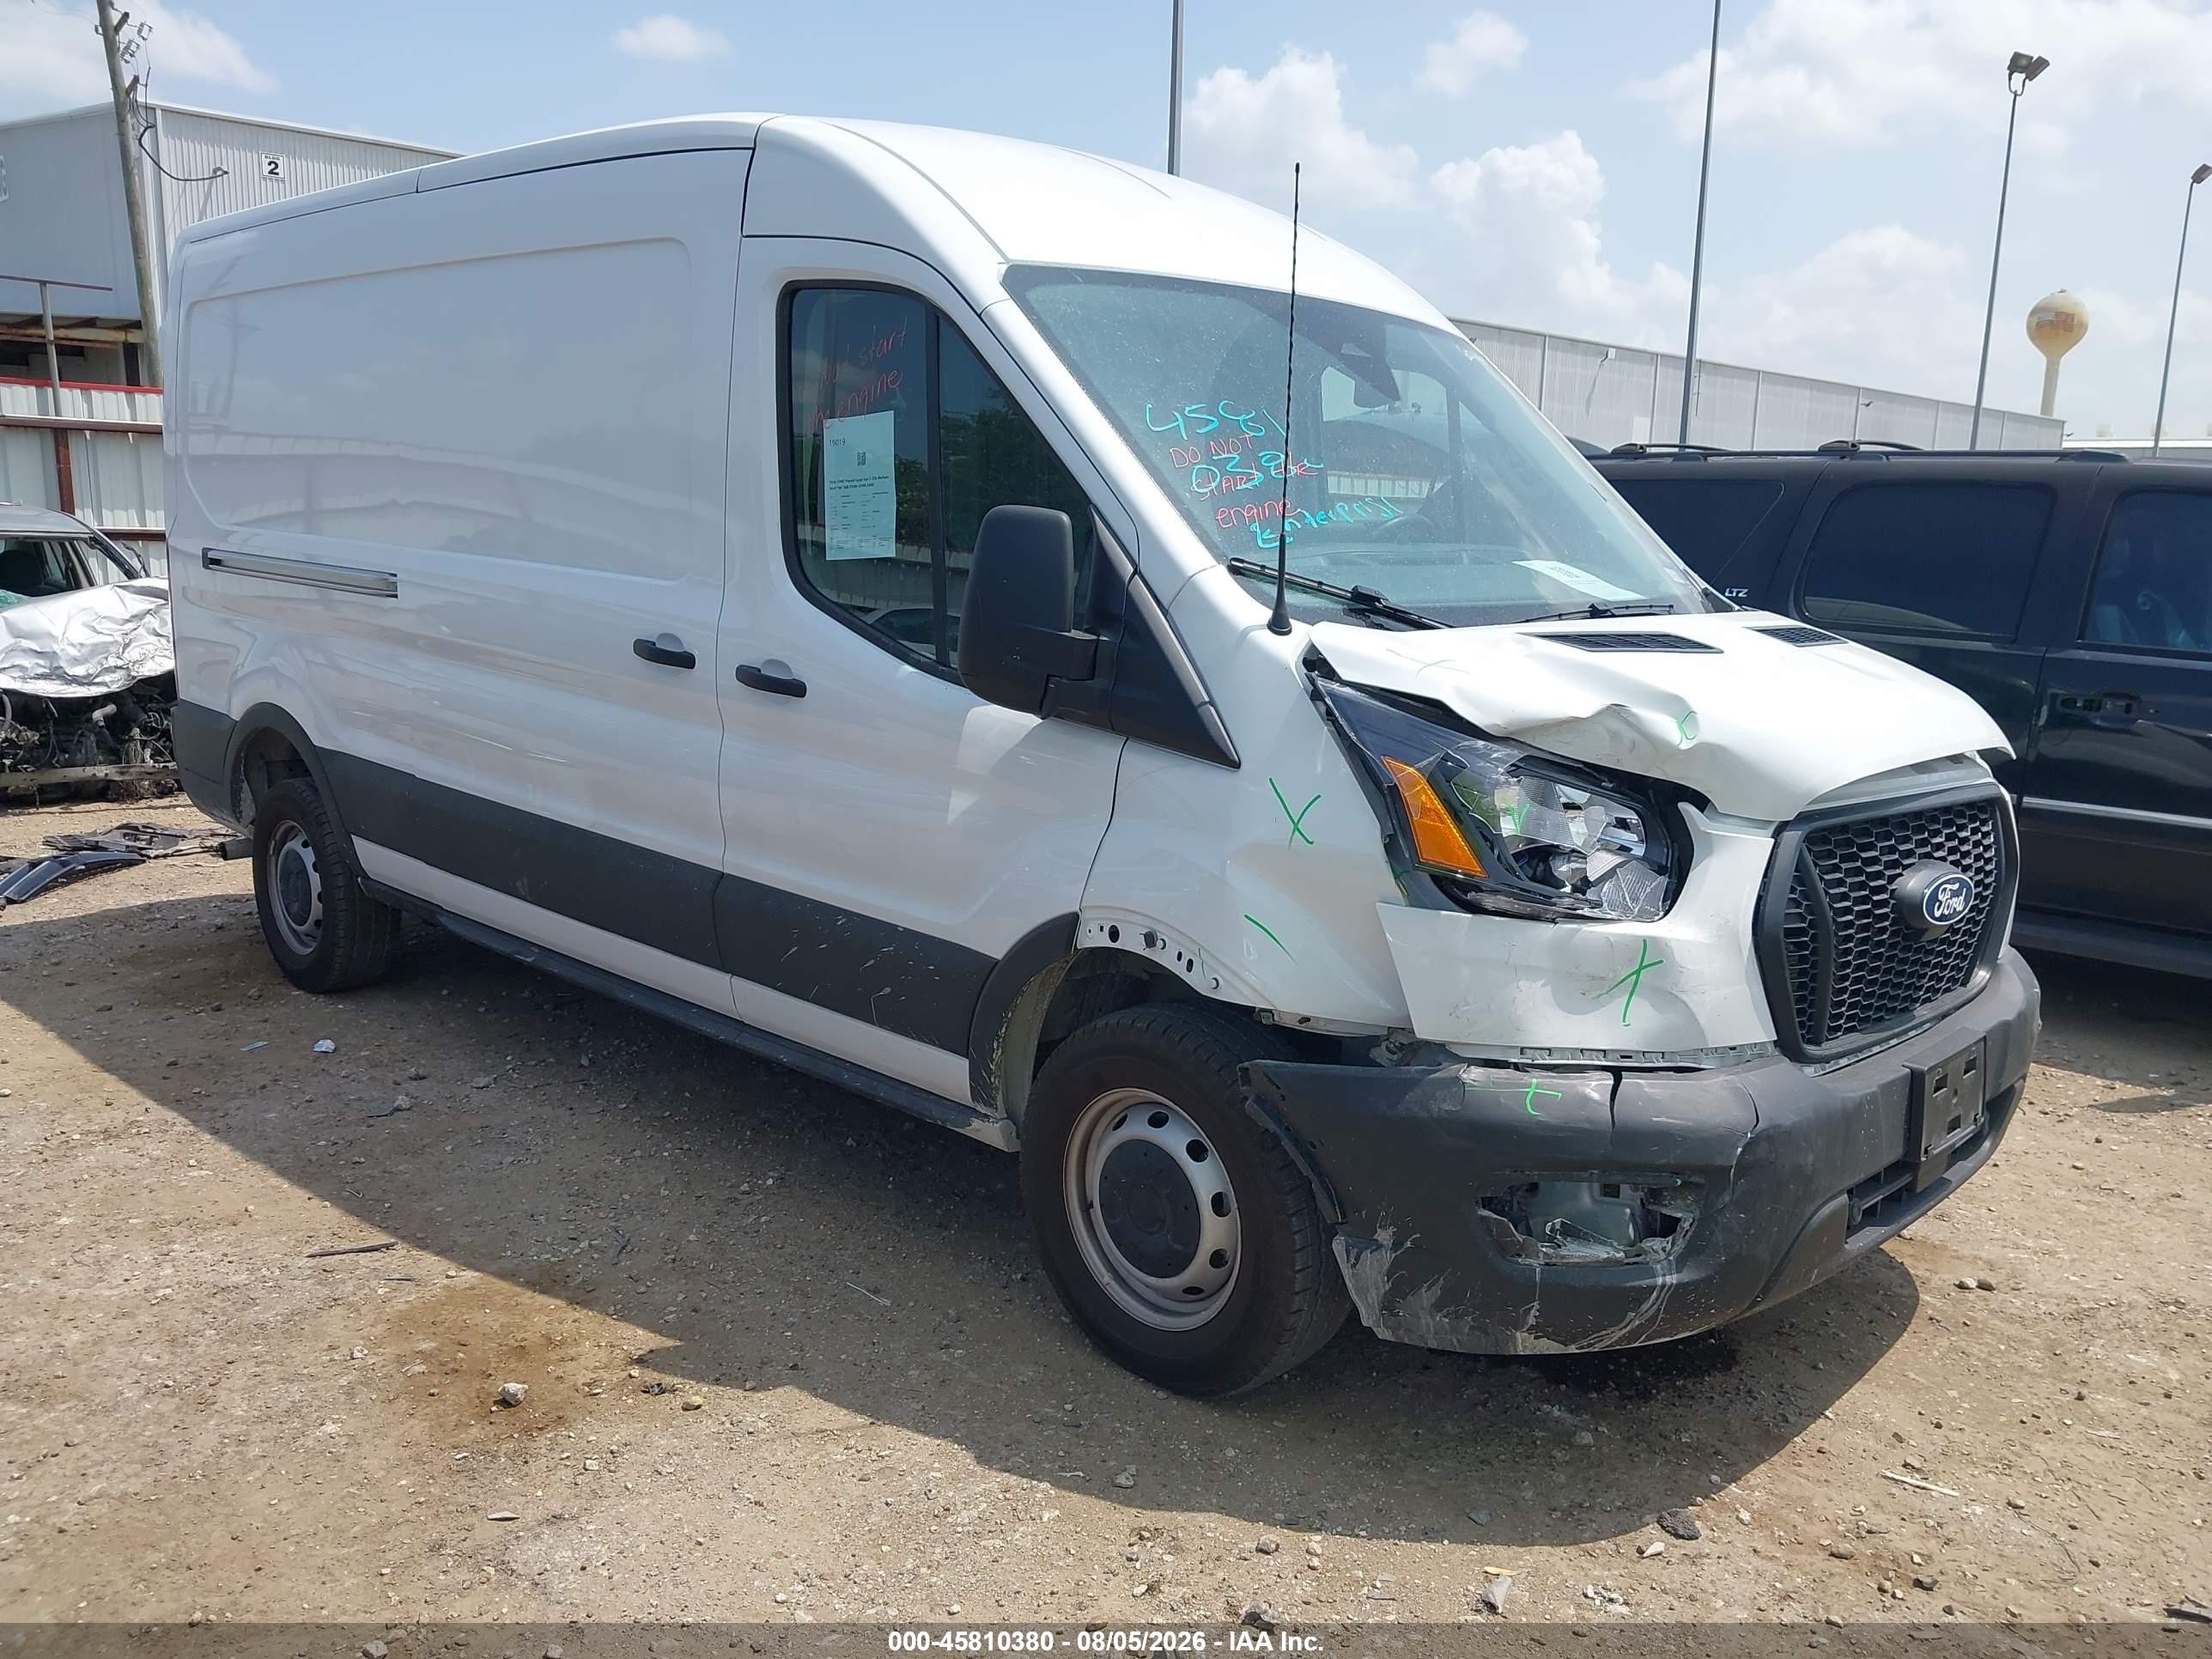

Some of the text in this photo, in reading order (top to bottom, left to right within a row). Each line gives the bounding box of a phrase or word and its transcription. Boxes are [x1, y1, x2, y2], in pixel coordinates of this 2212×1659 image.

[267, 161, 279, 176] 2
[837, 370, 904, 422] engine
[1169, 434, 1254, 469] DO NOT
[1216, 501, 1300, 529] engine
[1724, 587, 1748, 598] LTZ
[1934, 883, 1966, 918] Ford
